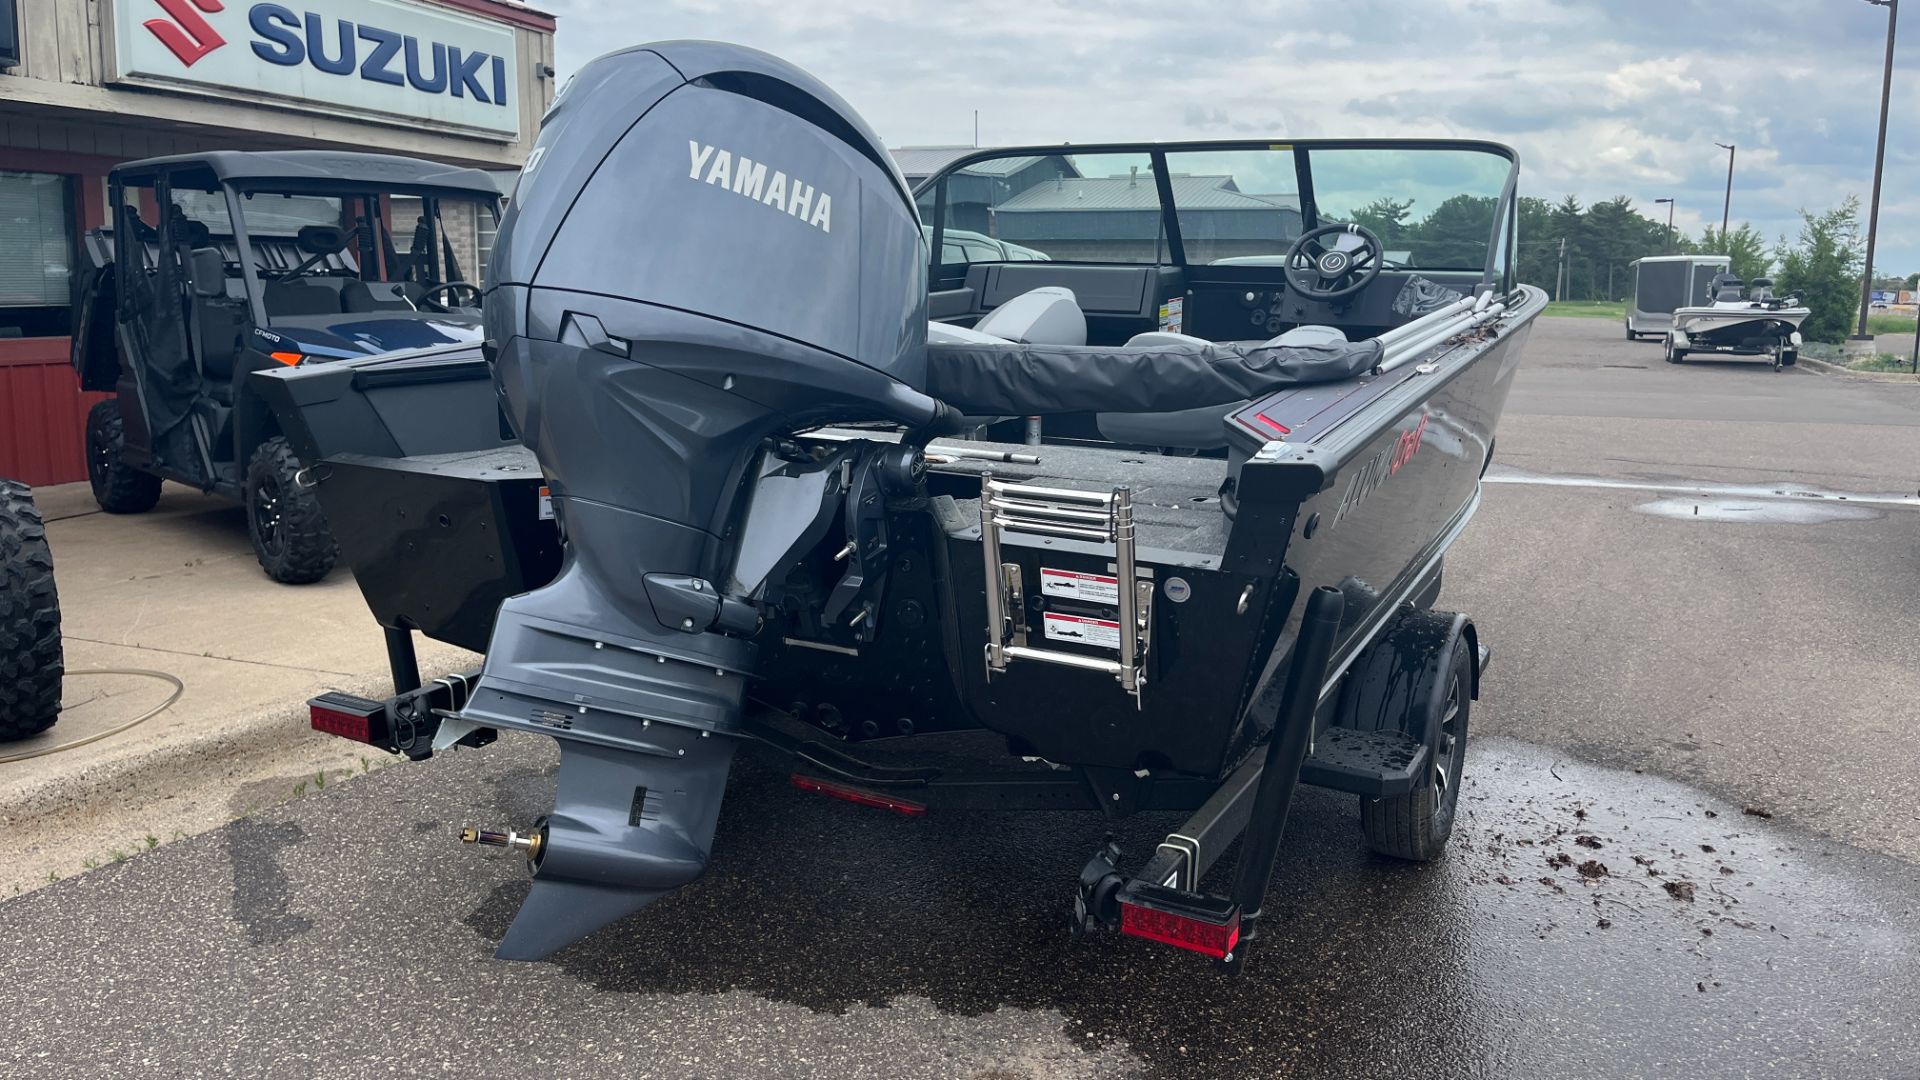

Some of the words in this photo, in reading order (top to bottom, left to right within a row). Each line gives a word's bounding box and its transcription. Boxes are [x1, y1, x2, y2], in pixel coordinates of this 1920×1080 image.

[248, 3, 507, 106] SUZUKI
[689, 140, 832, 233] YAMAHA
[254, 328, 280, 342] CFMOTO
